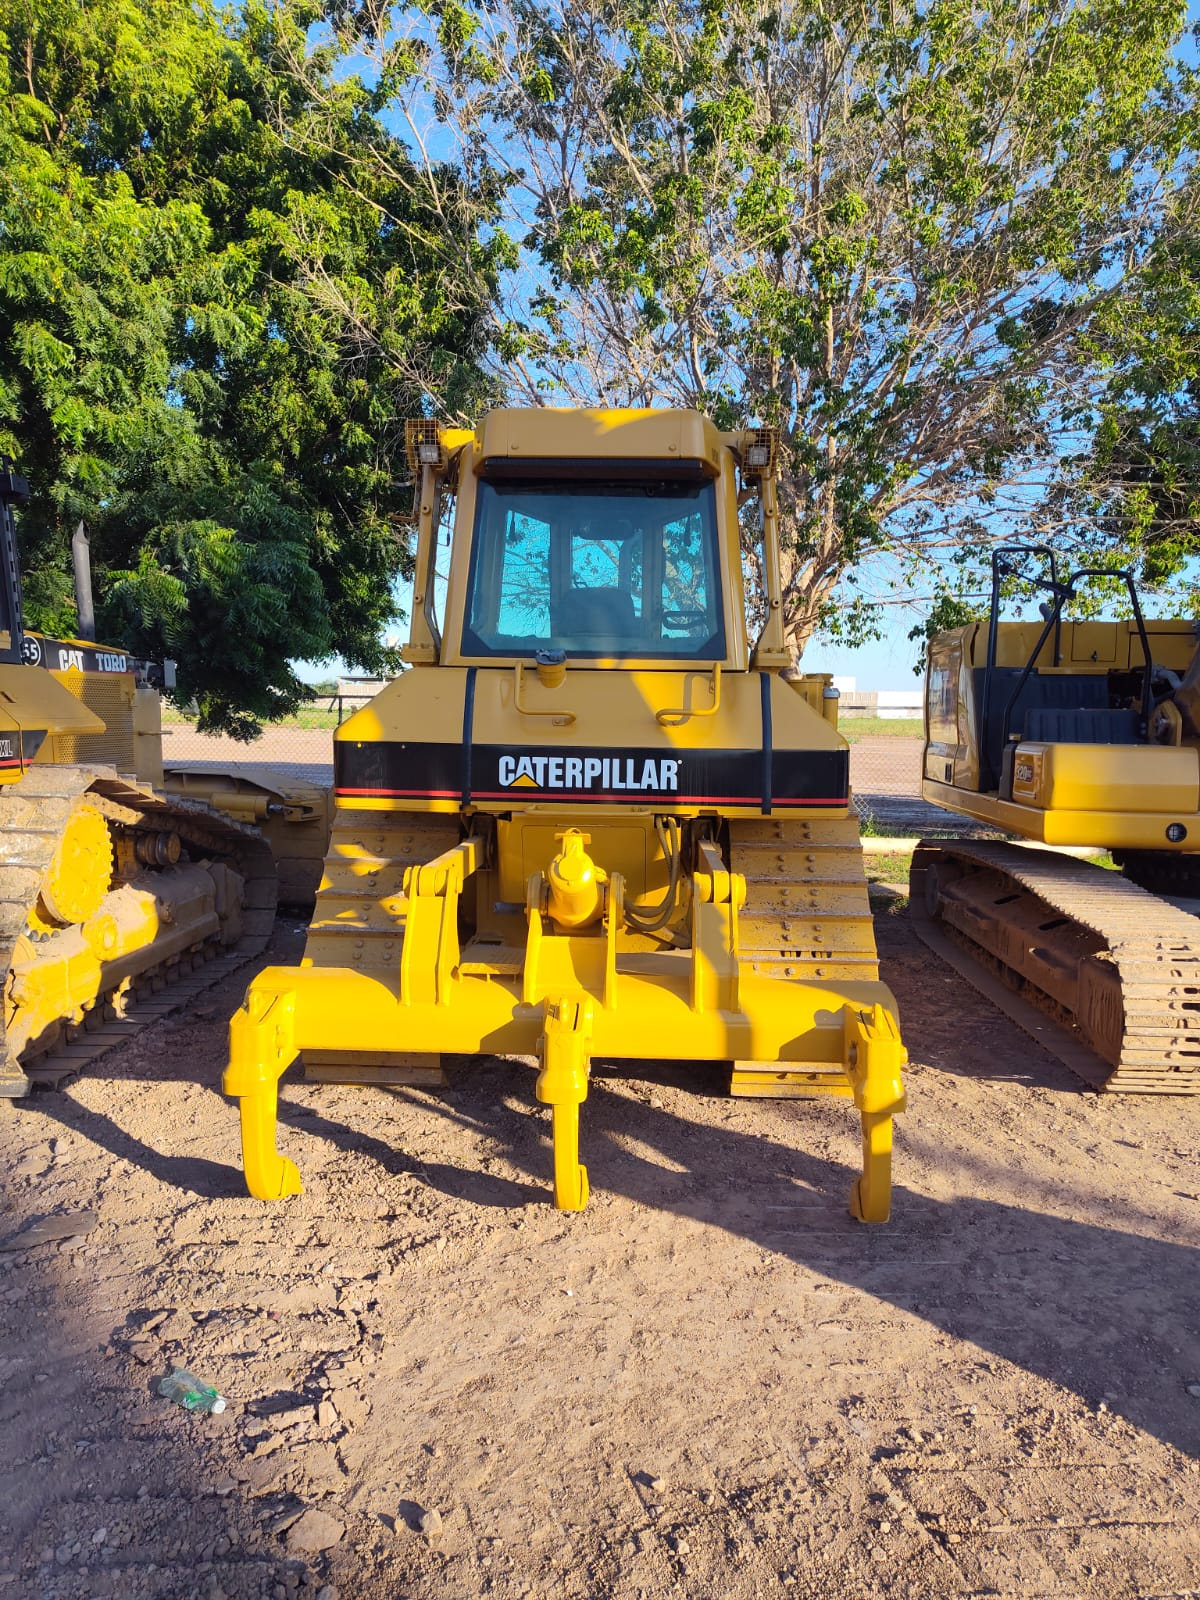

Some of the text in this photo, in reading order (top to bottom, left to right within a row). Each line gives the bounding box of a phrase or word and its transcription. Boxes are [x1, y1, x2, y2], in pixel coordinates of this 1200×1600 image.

[58, 649, 127, 672] CAT TORO
[498, 756, 678, 790] CATERPILLAR
